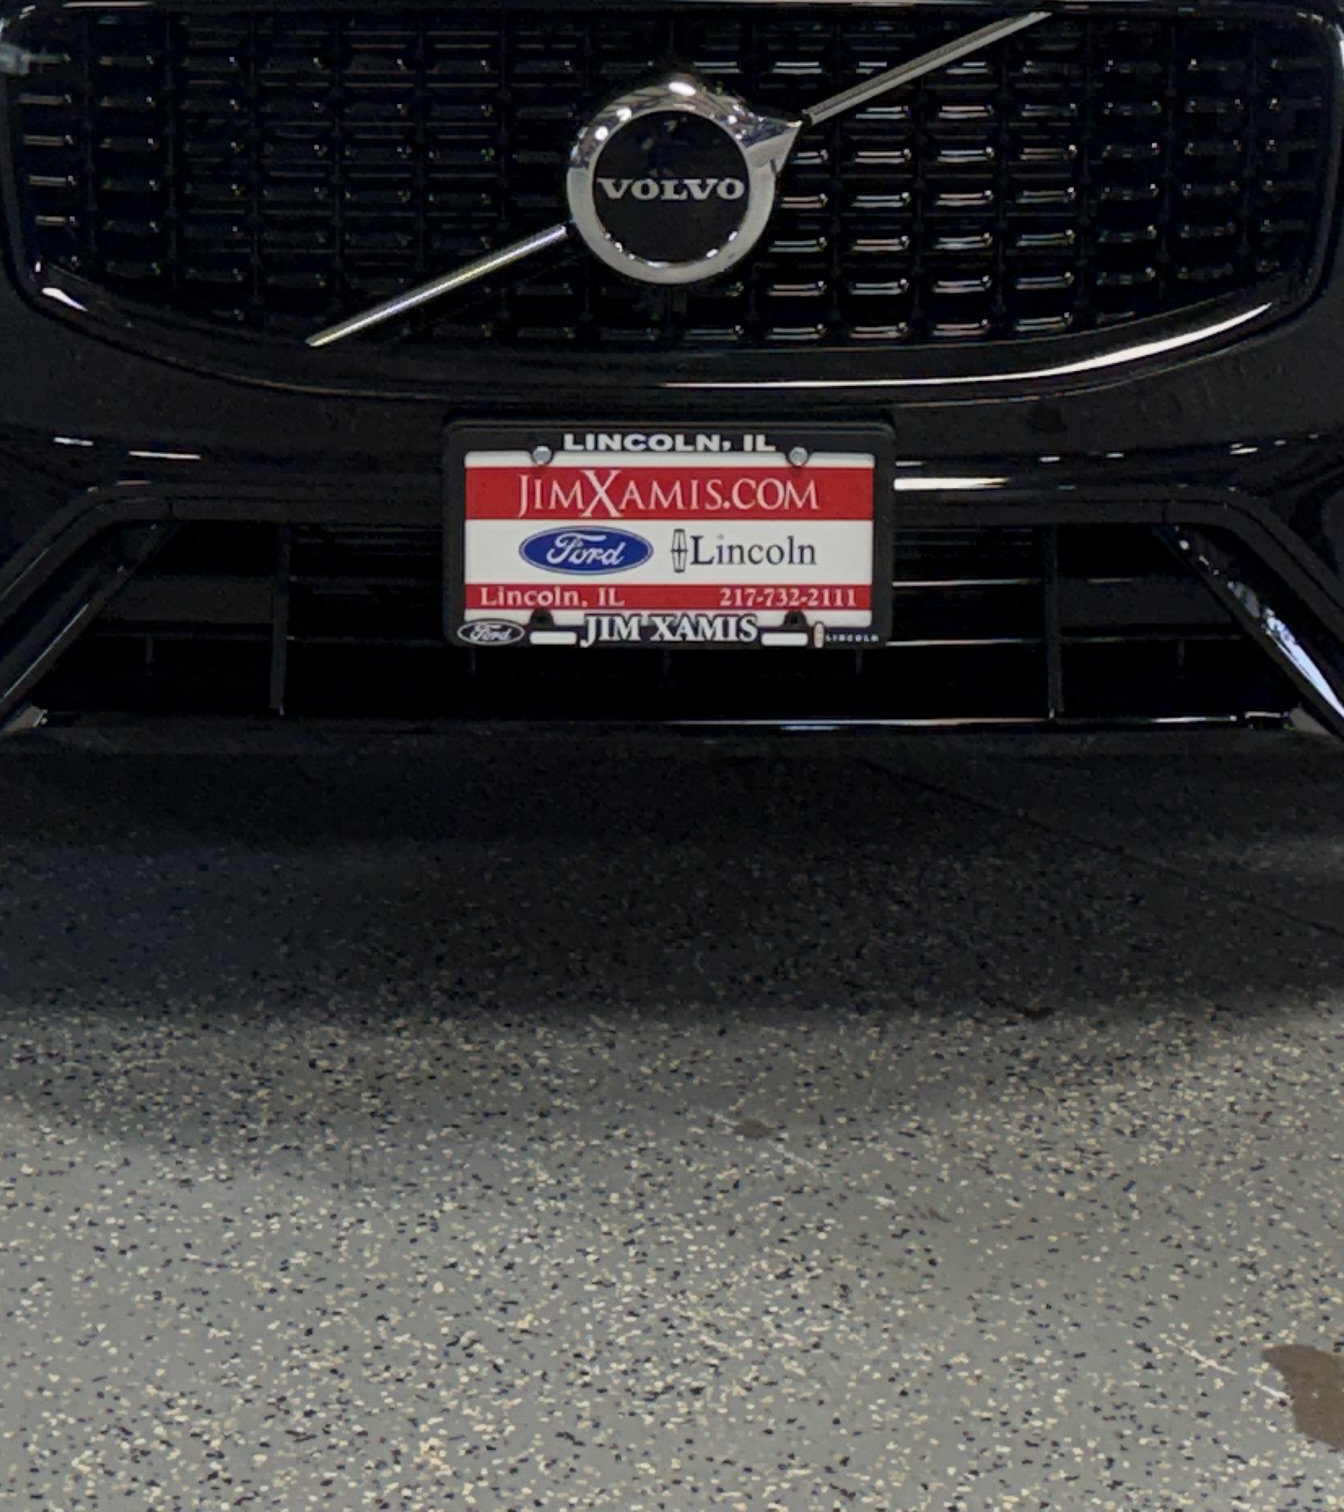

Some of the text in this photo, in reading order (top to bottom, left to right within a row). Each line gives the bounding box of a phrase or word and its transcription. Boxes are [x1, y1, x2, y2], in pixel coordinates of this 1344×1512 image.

[597, 178, 745, 201] VOLVO
[563, 434, 777, 452] LINCOLN, IL
[516, 469, 820, 519] JIMXAMIS.COM
[545, 532, 816, 566] Ford Lincoln
[597, 586, 626, 607] IL
[719, 588, 857, 607] 217-732-2111
[579, 615, 758, 648] JIM XAMIS
